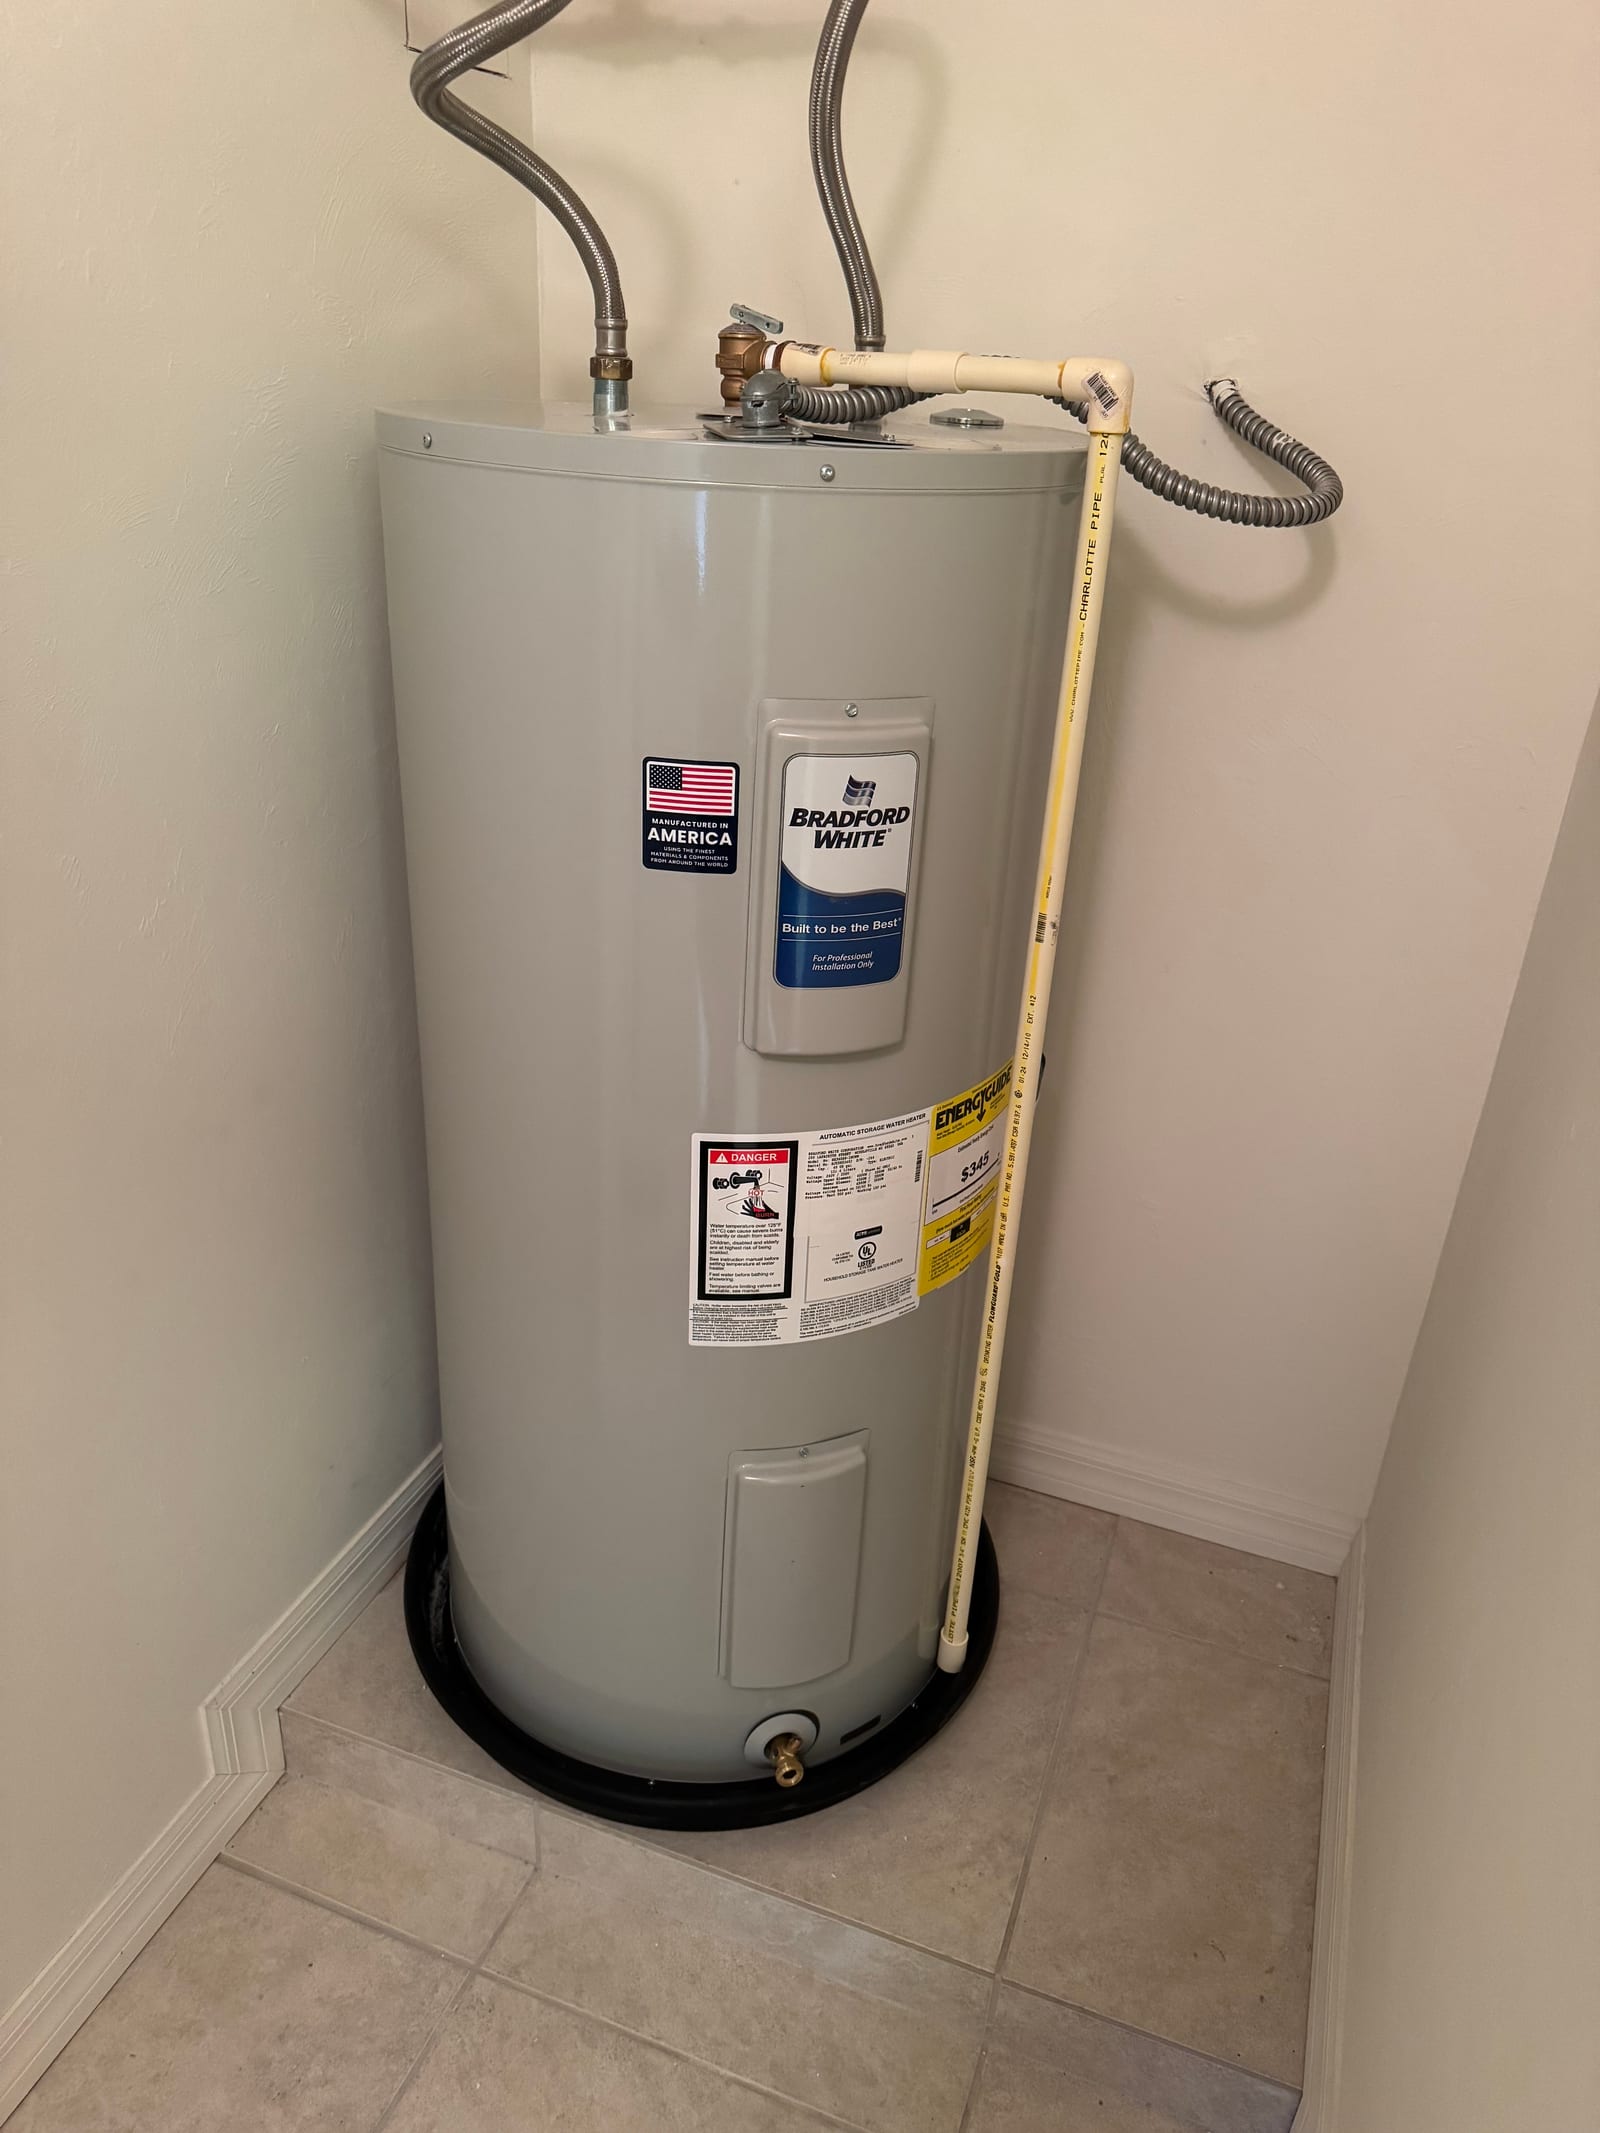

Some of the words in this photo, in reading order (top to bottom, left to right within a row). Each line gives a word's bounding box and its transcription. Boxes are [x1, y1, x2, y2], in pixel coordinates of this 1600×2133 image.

[1079, 539, 1096, 621] CHARLOTTE
[1090, 493, 1102, 531] PIPE
[652, 818, 717, 828] MANUFACTURED
[789, 806, 910, 827] BRADFORD
[648, 827, 732, 846] AMERICA
[814, 829, 887, 849] WHITE
[782, 923, 810, 934] Built
[814, 924, 827, 934] to
[831, 923, 847, 933] be
[851, 922, 870, 932] the
[873, 918, 898, 930] Best
[812, 961, 856, 971] Installation
[857, 960, 874, 968] Only
[813, 954, 826, 962] For
[827, 951, 873, 962] Professional
[1022, 1032, 1031, 1060] 12/14/10
[935, 1065, 1012, 1130] ENERGYGUIDE
[819, 1131, 855, 1140] AUTOMATIC
[857, 1125, 885, 1134] STORAGE
[886, 1119, 905, 1129] WATER
[906, 1113, 926, 1124] HEATER
[961, 1150, 989, 1183] $345
[1002, 1195, 1010, 1207] U.S.
[1000, 1223, 1006, 1231] IN
[824, 1274, 848, 1282] HOUSEHOLD
[890, 1258, 903, 1266] HEATER
[858, 1258, 875, 1267] LISTED
[983, 1340, 992, 1364] DRINKING
